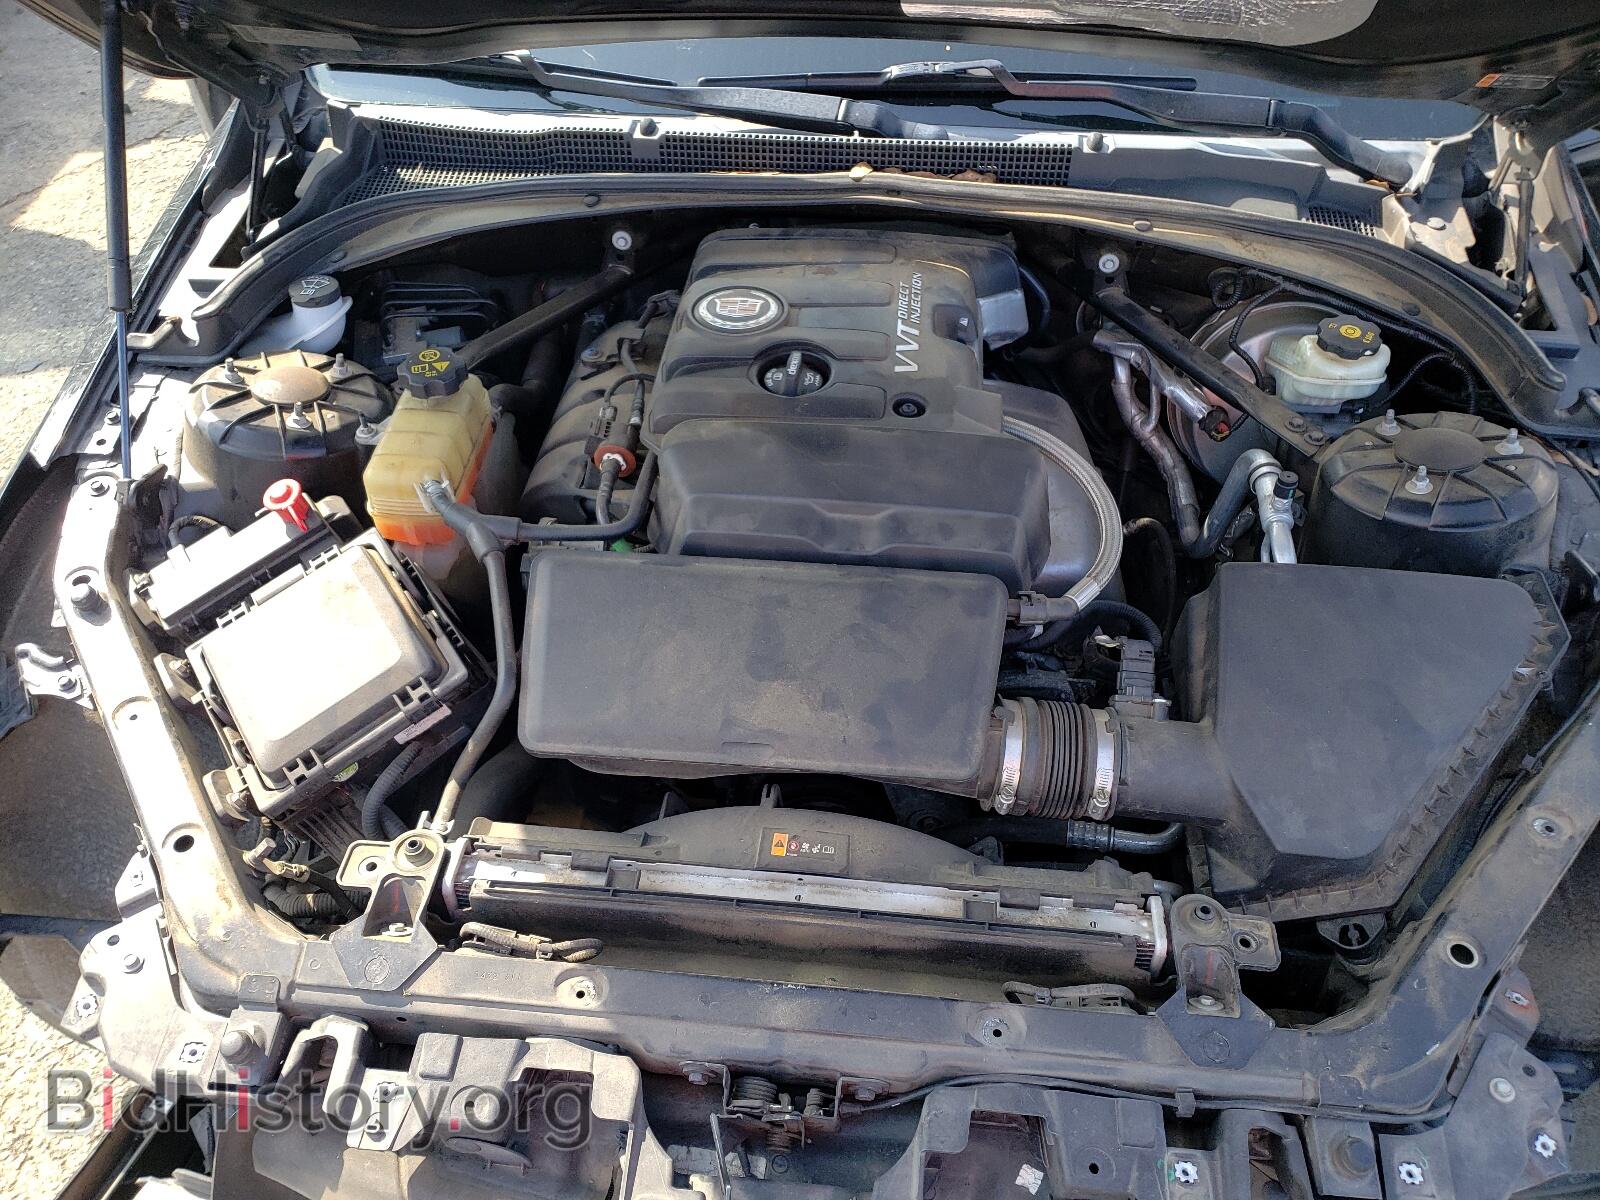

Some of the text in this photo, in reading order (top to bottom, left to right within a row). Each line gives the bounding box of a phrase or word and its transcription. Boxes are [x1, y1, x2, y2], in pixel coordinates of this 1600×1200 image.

[897, 281, 910, 320] DIRECT
[910, 271, 922, 323] INJECTION
[894, 318, 920, 372] VVT
